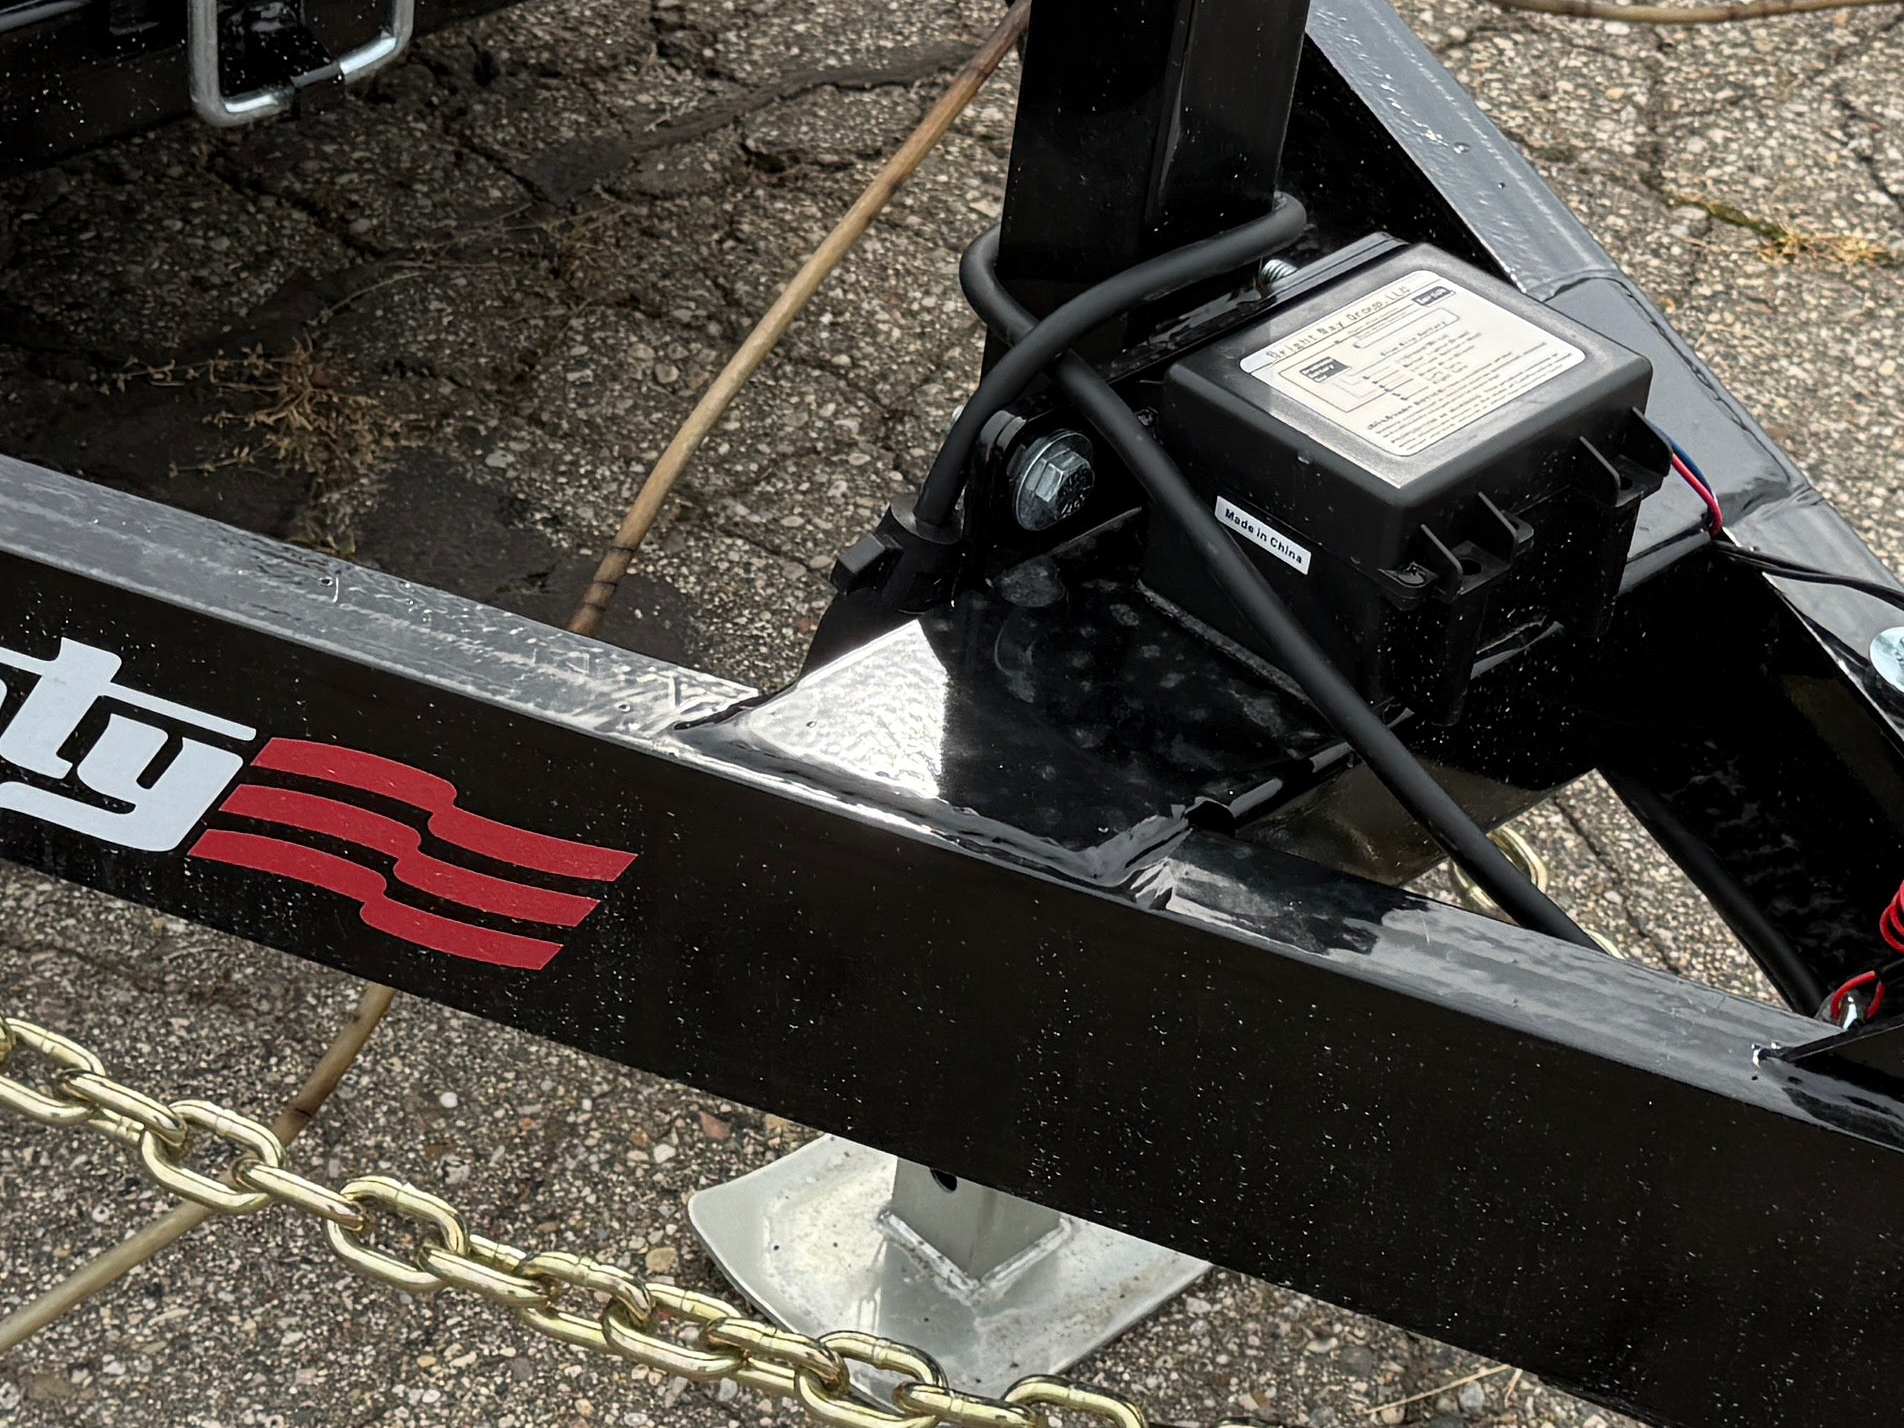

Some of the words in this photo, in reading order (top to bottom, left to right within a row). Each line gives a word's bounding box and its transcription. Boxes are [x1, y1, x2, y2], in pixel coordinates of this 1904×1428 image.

[1224, 508, 1254, 533] Made
[1256, 528, 1267, 542] in
[1270, 537, 1302, 564] China
